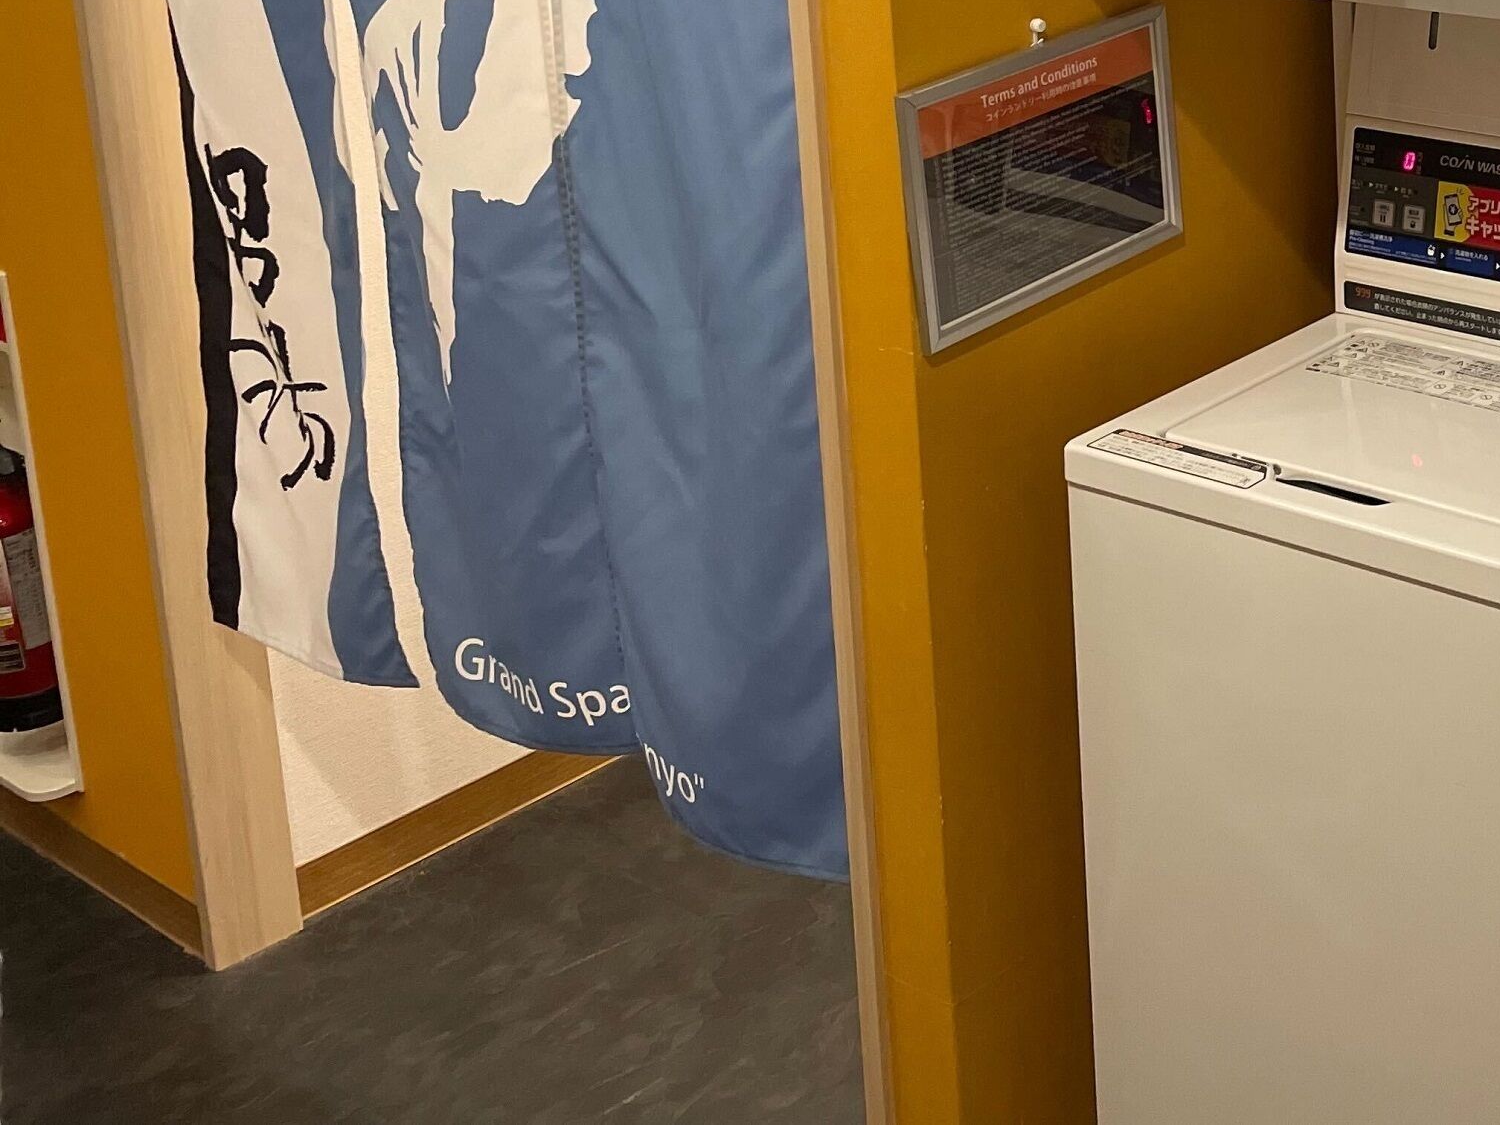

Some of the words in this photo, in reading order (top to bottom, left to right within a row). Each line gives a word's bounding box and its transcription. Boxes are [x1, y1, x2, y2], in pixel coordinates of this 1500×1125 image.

[980, 87, 1016, 108] Terms
[1018, 76, 1039, 95] and
[1041, 56, 1098, 86] Conditions
[1403, 152, 1416, 170] 0
[455, 638, 545, 715] Grand
[549, 681, 631, 726] Spa
[637, 735, 704, 803] nyo"
